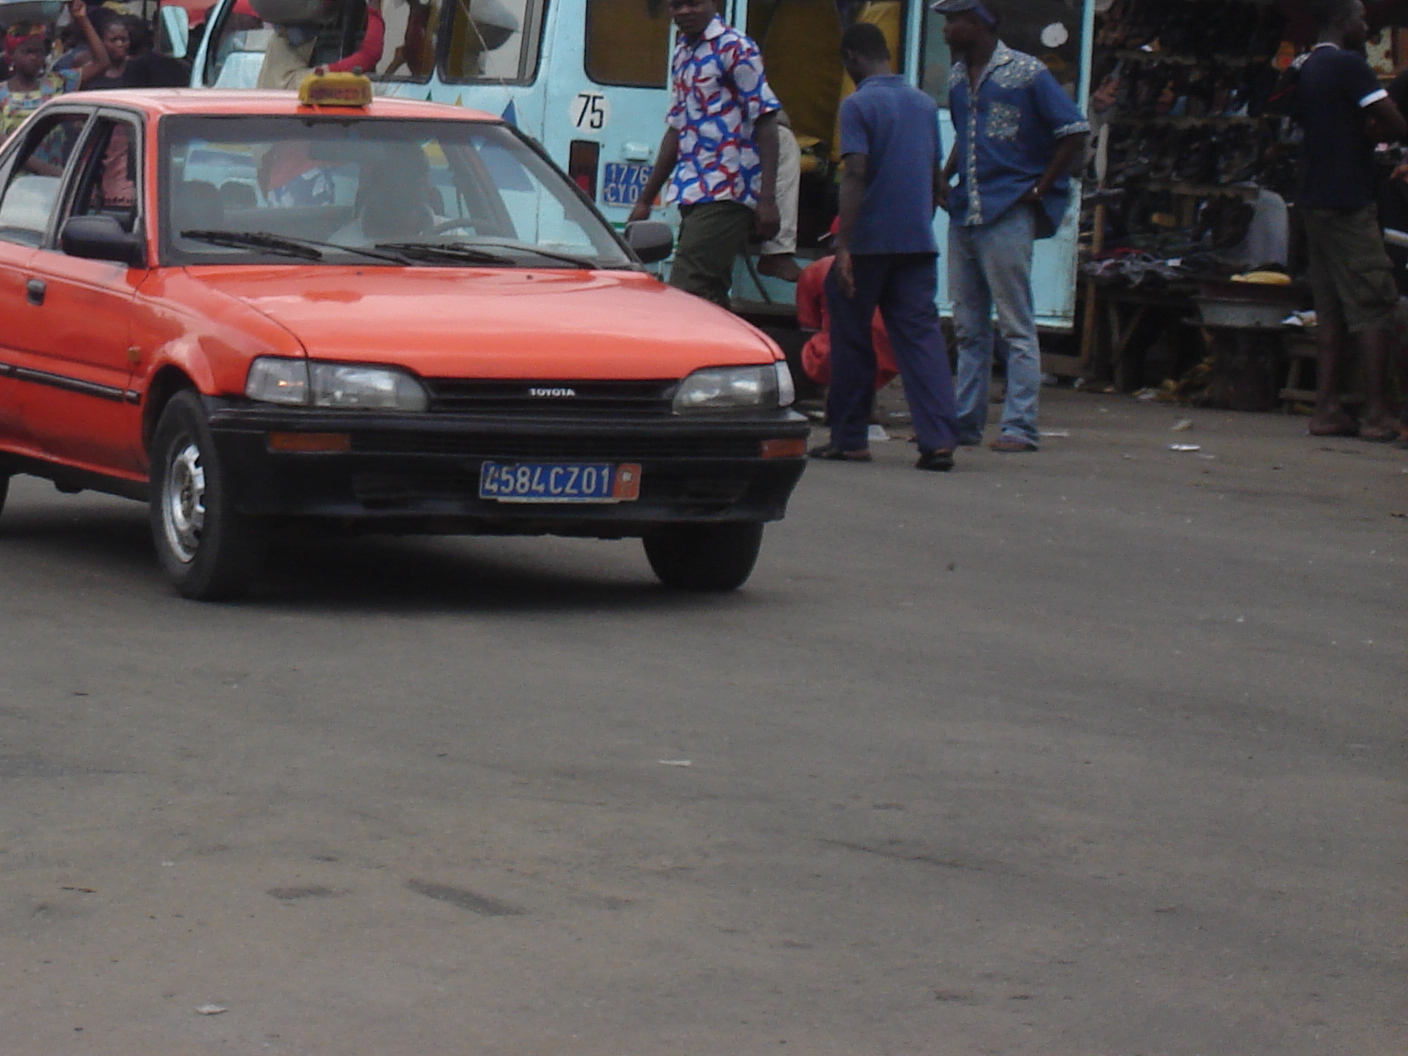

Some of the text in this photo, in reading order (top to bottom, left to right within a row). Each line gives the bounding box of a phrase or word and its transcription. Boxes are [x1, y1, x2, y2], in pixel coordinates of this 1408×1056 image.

[576, 94, 604, 129] 75
[606, 184, 642, 203] CY0
[529, 387, 576, 397] TOYOTA
[484, 465, 611, 495] 4584CZ01
